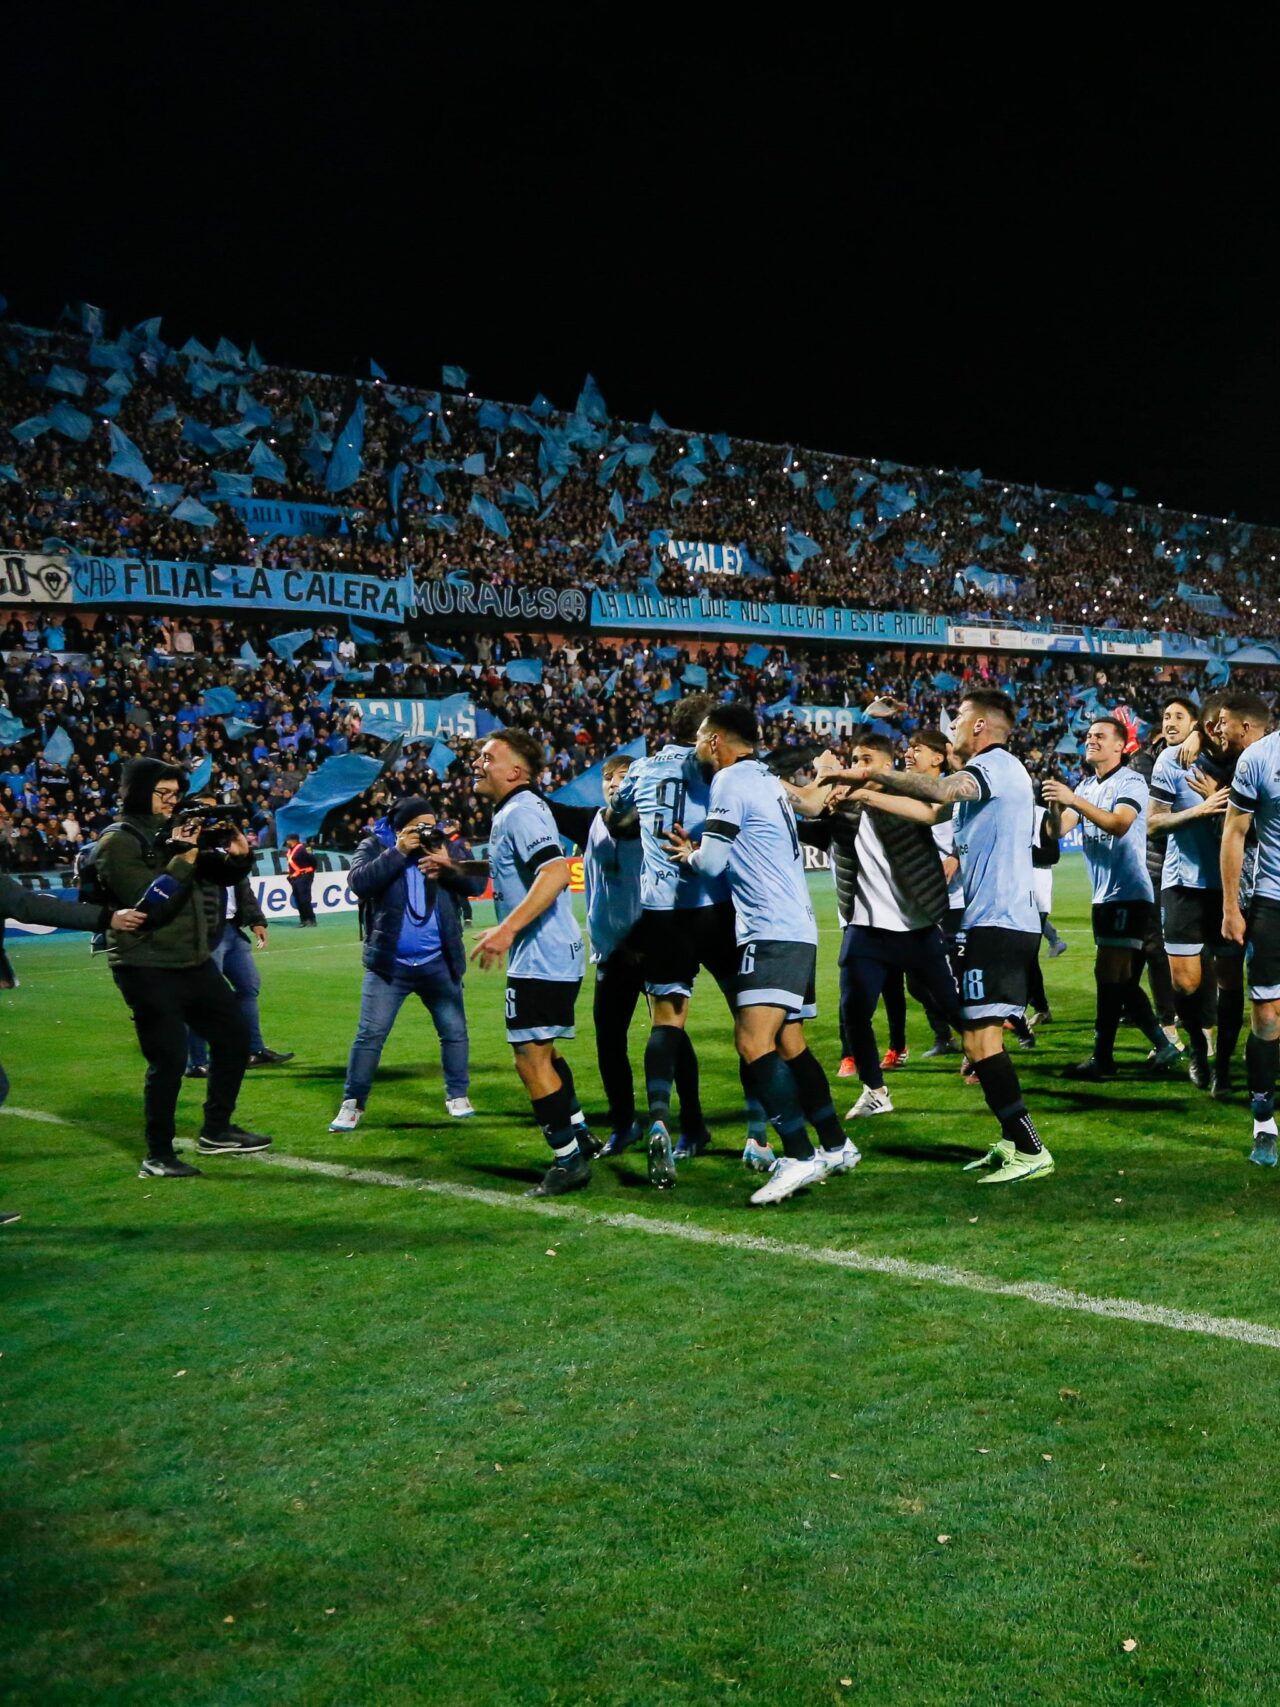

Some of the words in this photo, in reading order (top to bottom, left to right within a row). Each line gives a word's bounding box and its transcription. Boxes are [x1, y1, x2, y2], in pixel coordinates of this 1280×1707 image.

[124, 562, 222, 599] FILIAL
[231, 567, 272, 599] LA
[282, 570, 401, 617] CALERA
[409, 580, 558, 620] MURALES
[740, 600, 772, 625] NOS
[780, 603, 826, 630] LLEVA
[833, 609, 844, 632] A
[850, 610, 886, 633] ESTE
[894, 613, 940, 637] RITUAL
